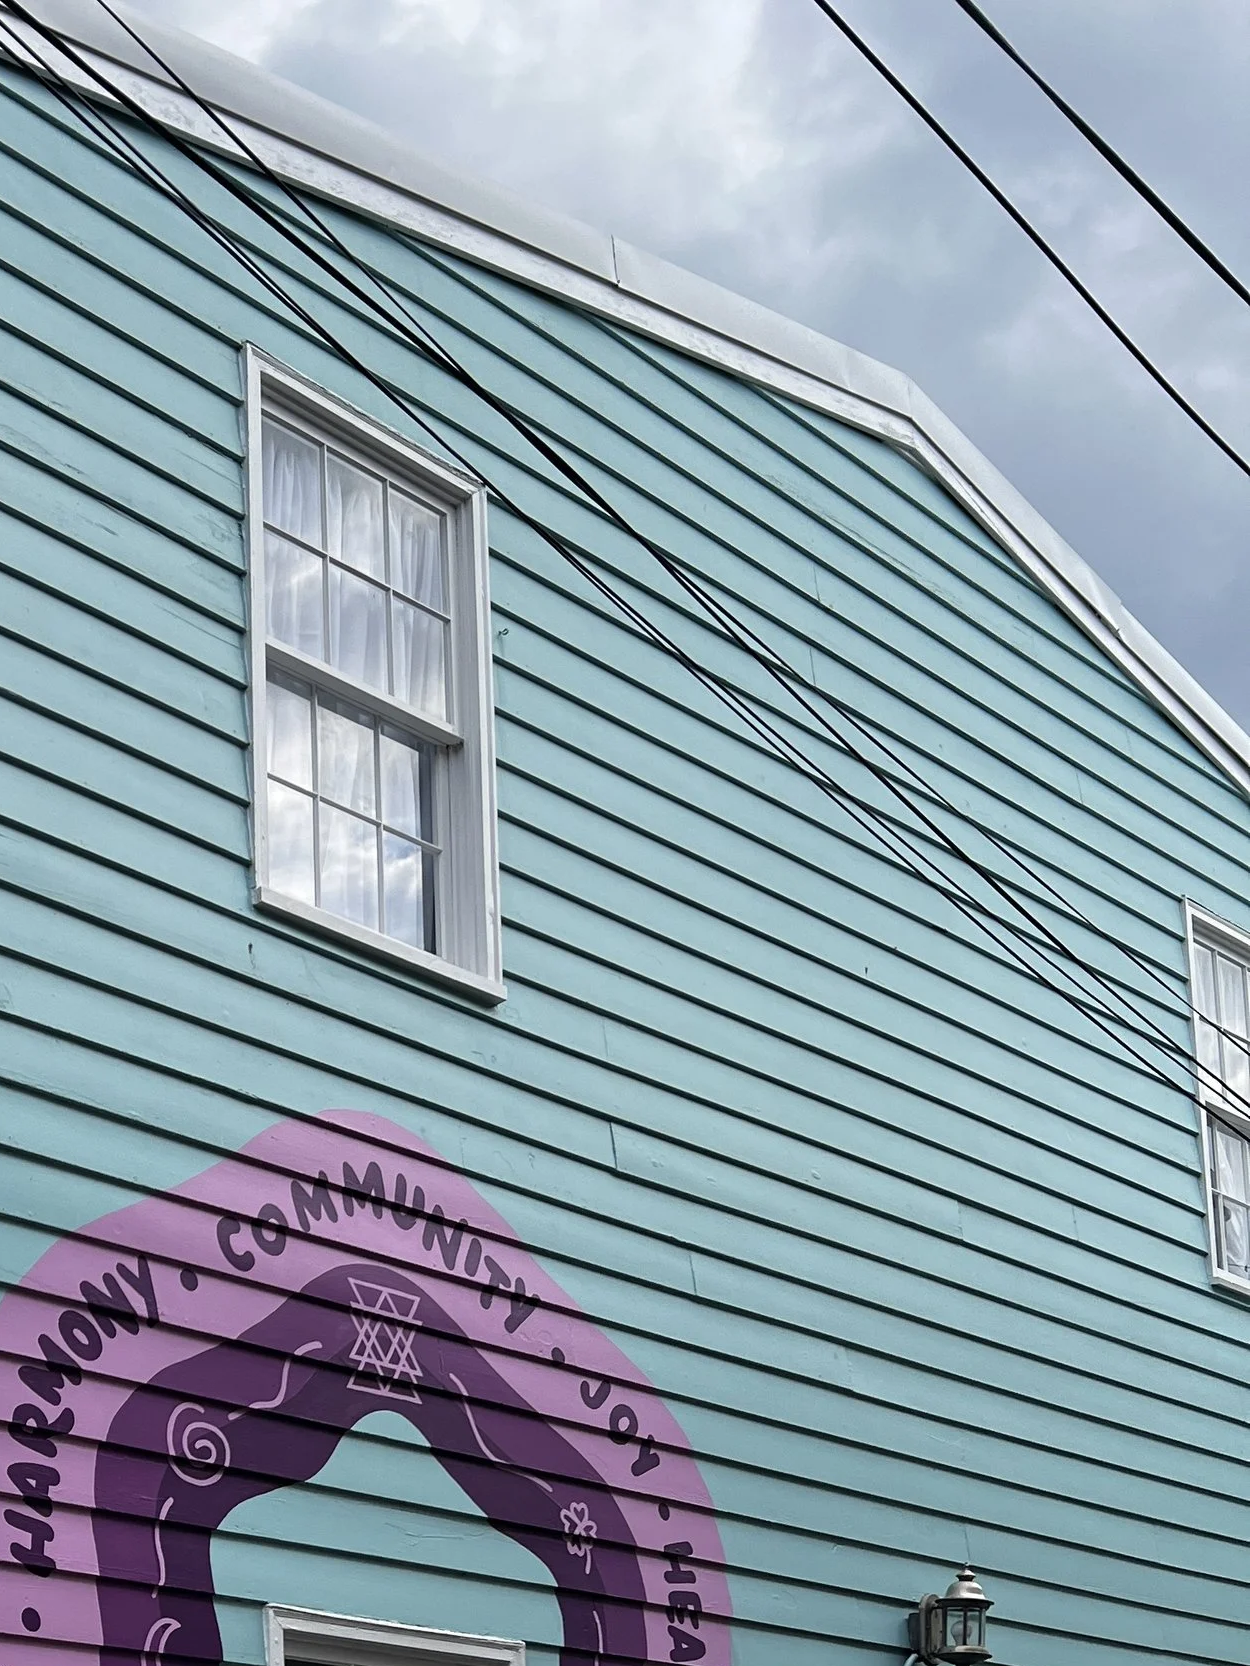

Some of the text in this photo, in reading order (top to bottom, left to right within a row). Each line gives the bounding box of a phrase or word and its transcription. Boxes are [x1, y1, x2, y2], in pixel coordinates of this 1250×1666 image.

[4, 1255, 159, 1578] HARMONY
[216, 1161, 540, 1334] COMMUNITY
[580, 1377, 660, 1476] JOY
